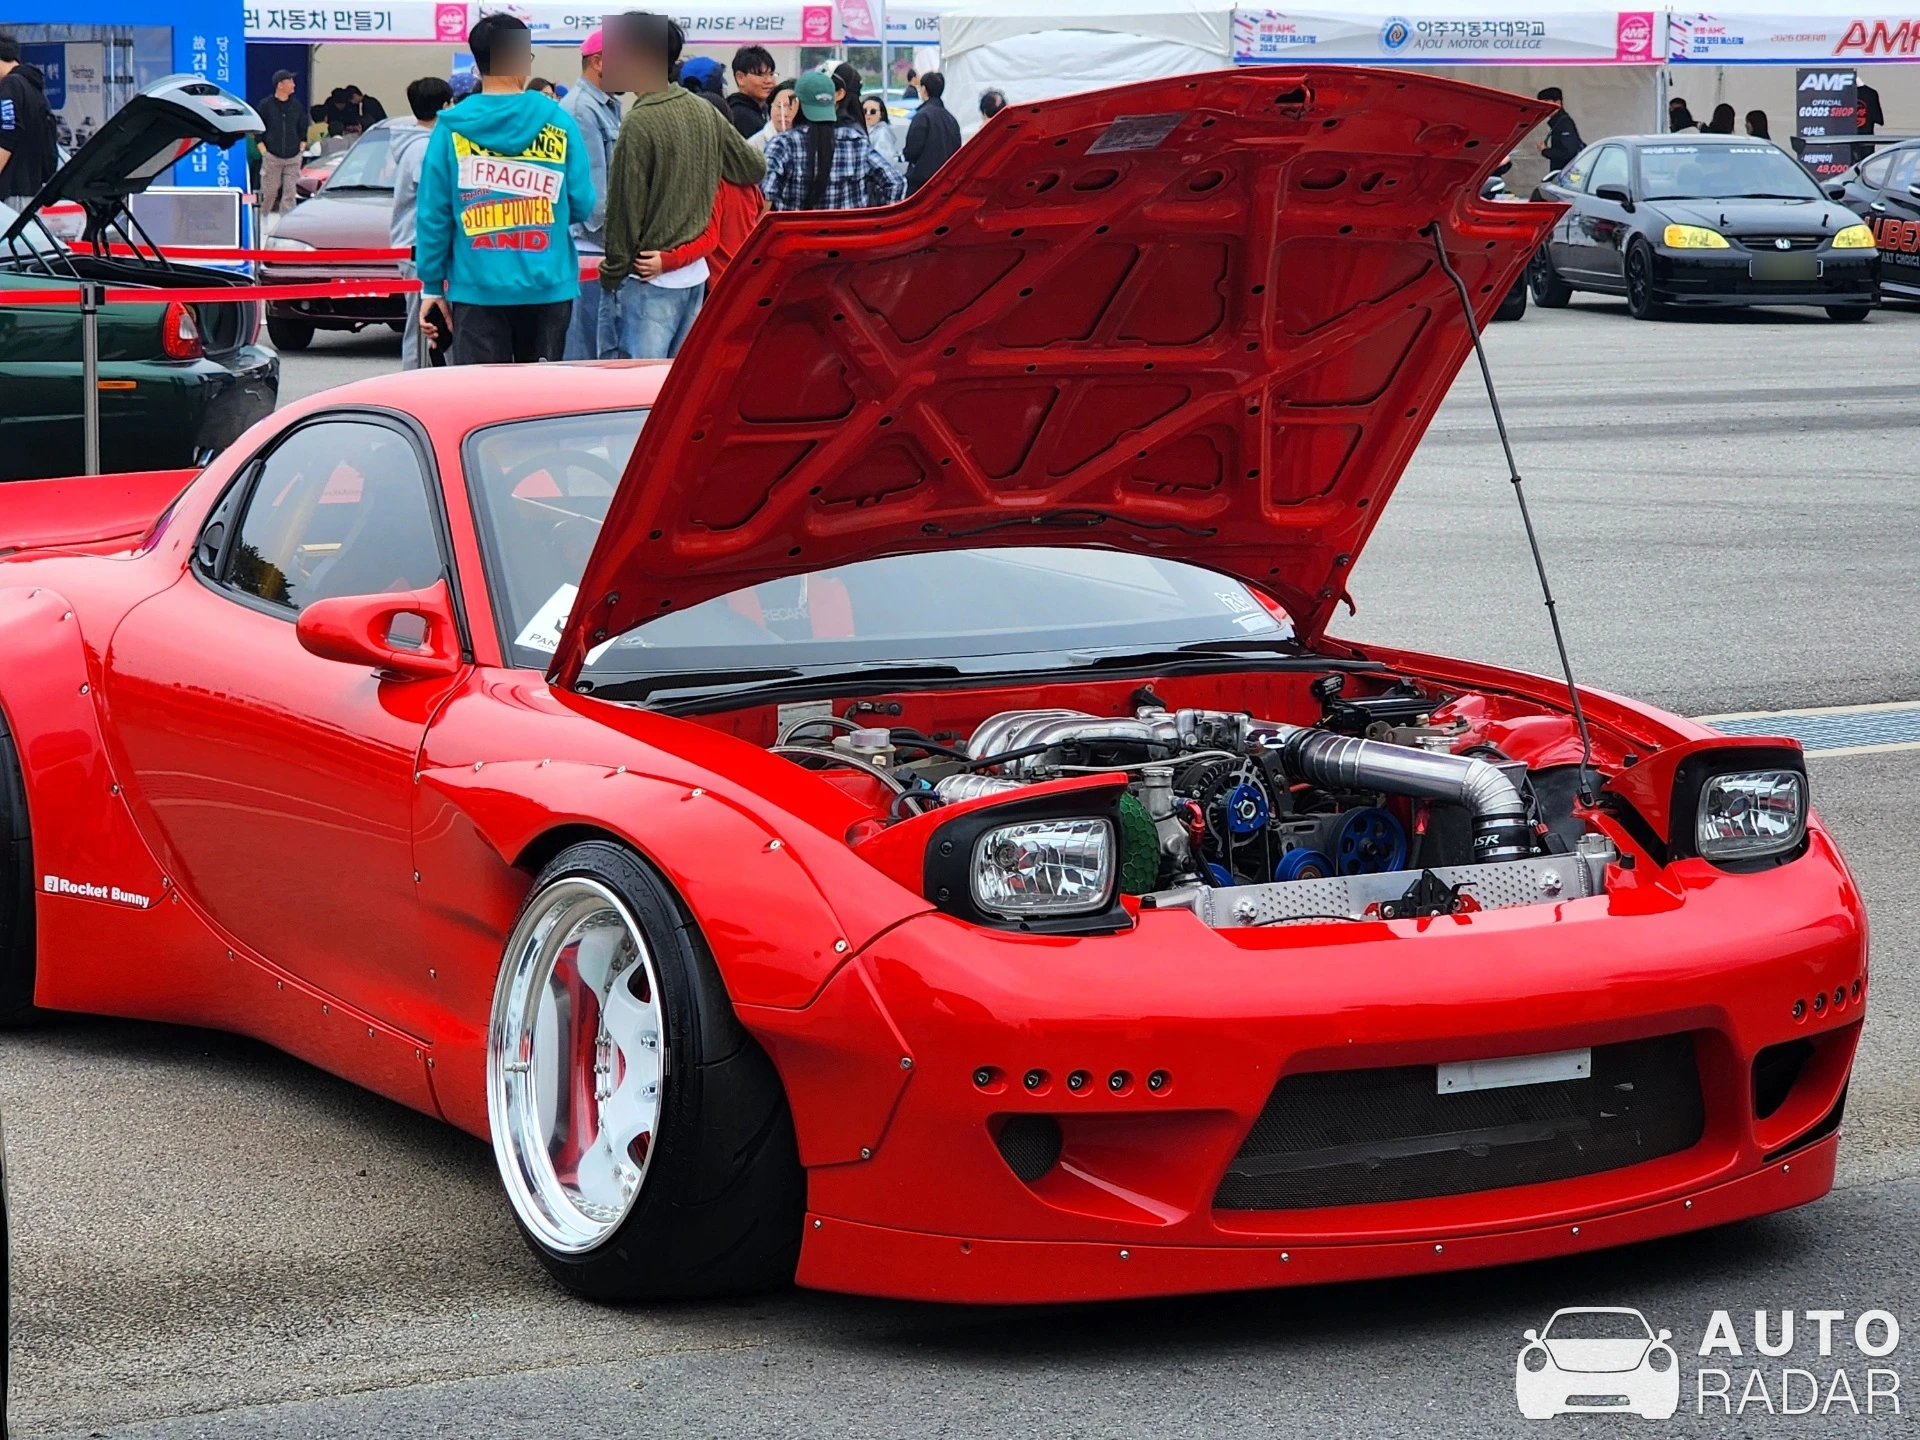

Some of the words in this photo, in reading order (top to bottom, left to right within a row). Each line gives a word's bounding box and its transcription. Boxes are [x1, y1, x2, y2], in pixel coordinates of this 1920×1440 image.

[268, 9, 327, 31] 자동차
[334, 10, 392, 31] 만들기
[696, 16, 737, 30] RISE
[739, 16, 785, 31] 사업단
[915, 17, 939, 31] 아주
[1416, 20, 1546, 38] 아주자동차대학교
[1414, 39, 1444, 51] AJOU
[1450, 39, 1489, 49] MOTOR
[1493, 39, 1543, 49] COLLEGE
[1832, 20, 1920, 56] AM
[216, 36, 229, 83] 당신의
[1799, 73, 1854, 91] AMF
[1799, 106, 1829, 117] GOODS
[1830, 107, 1854, 117] SHOP
[475, 162, 555, 195] FRAGILE
[502, 196, 552, 227] POWER
[471, 230, 549, 252] AND
[529, 633, 558, 648] PAN
[59, 878, 108, 899] Rocket
[111, 886, 150, 909] Bunny
